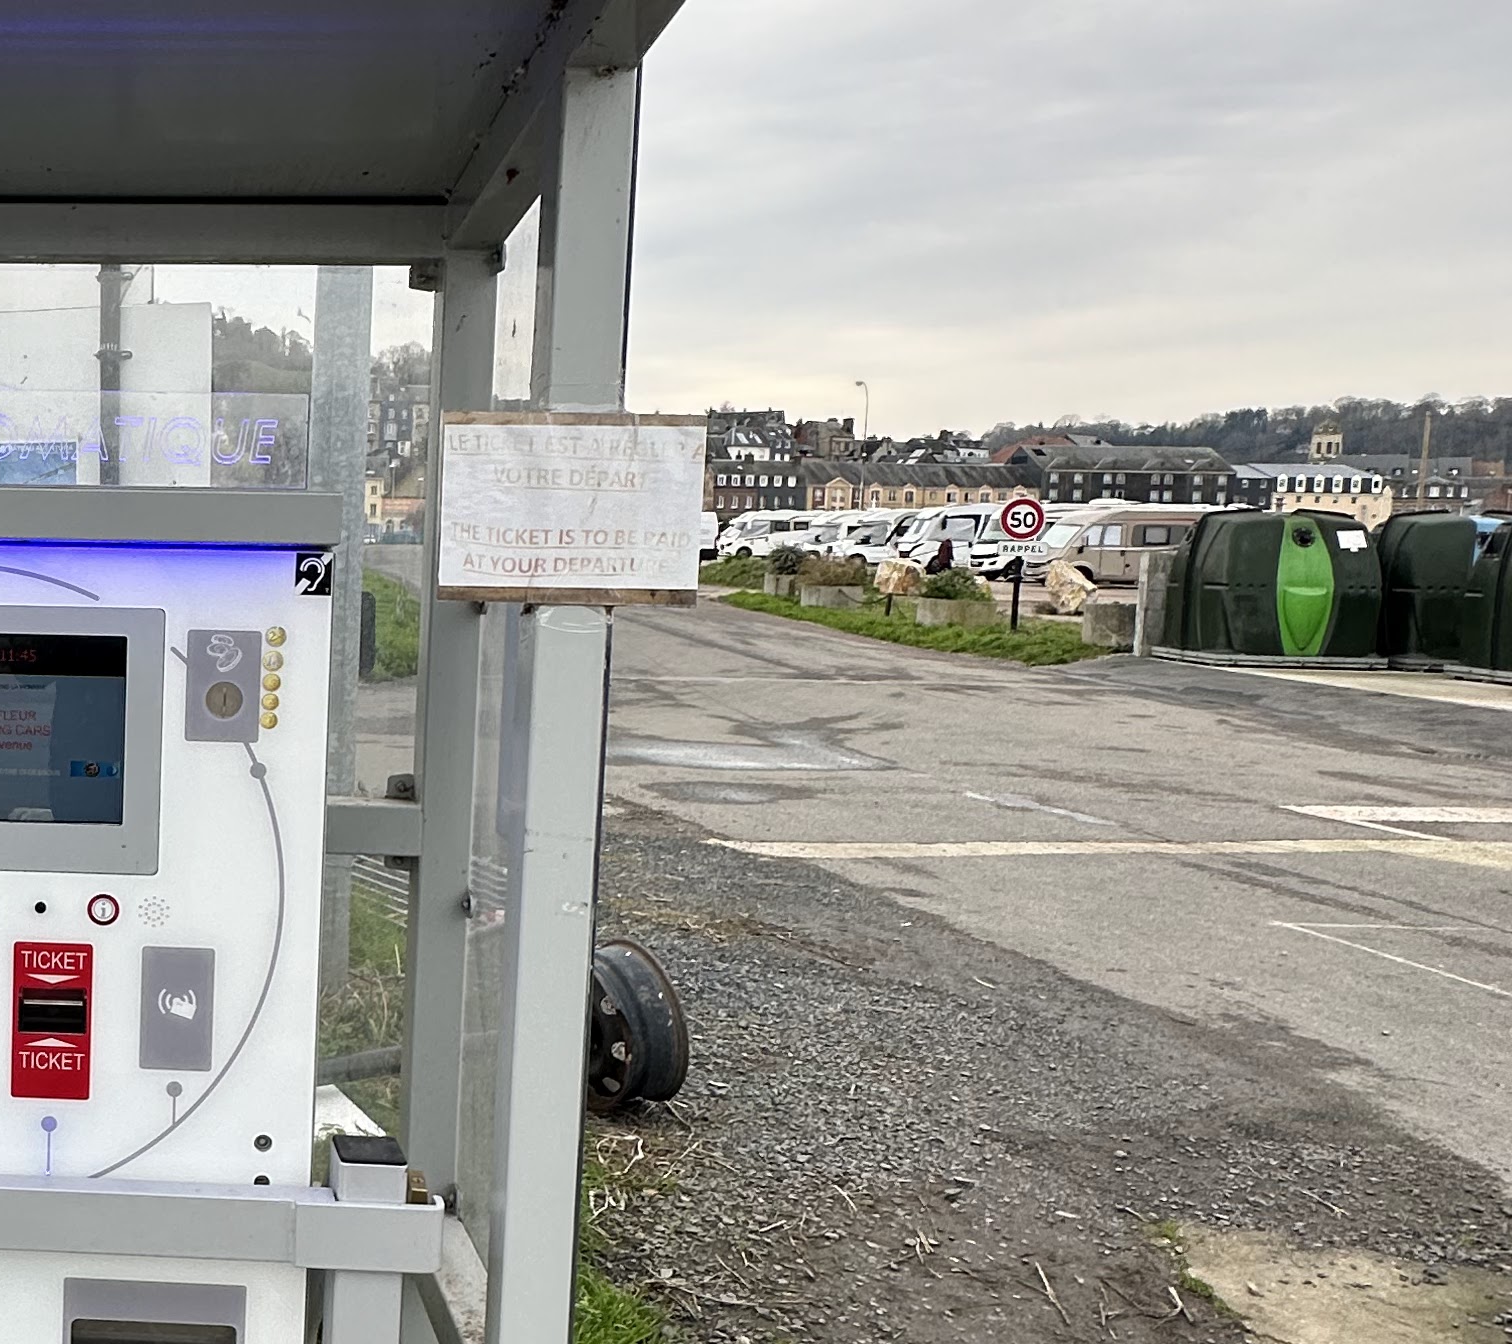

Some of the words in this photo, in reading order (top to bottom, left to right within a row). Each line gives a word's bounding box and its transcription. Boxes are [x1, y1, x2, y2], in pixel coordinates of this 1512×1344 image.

[449, 434, 469, 452] LE
[473, 434, 534, 453] TICET
[494, 464, 564, 486] VOTRE
[569, 463, 648, 489] DÉPART
[1010, 512, 1036, 528] 50
[451, 522, 480, 541] THE
[486, 527, 553, 545] TICKET
[558, 528, 575, 545] IS
[582, 529, 608, 545] TO
[615, 529, 637, 545] BE
[644, 530, 691, 547] PAID
[1002, 544, 1044, 553] RAPPEL
[463, 552, 486, 569] AT
[490, 556, 547, 574] YOUR
[0, 649, 37, 663] 11:45
[15, 725, 51, 737] CARS
[21, 950, 87, 970] TICKET
[18, 1051, 85, 1070] TICKET
